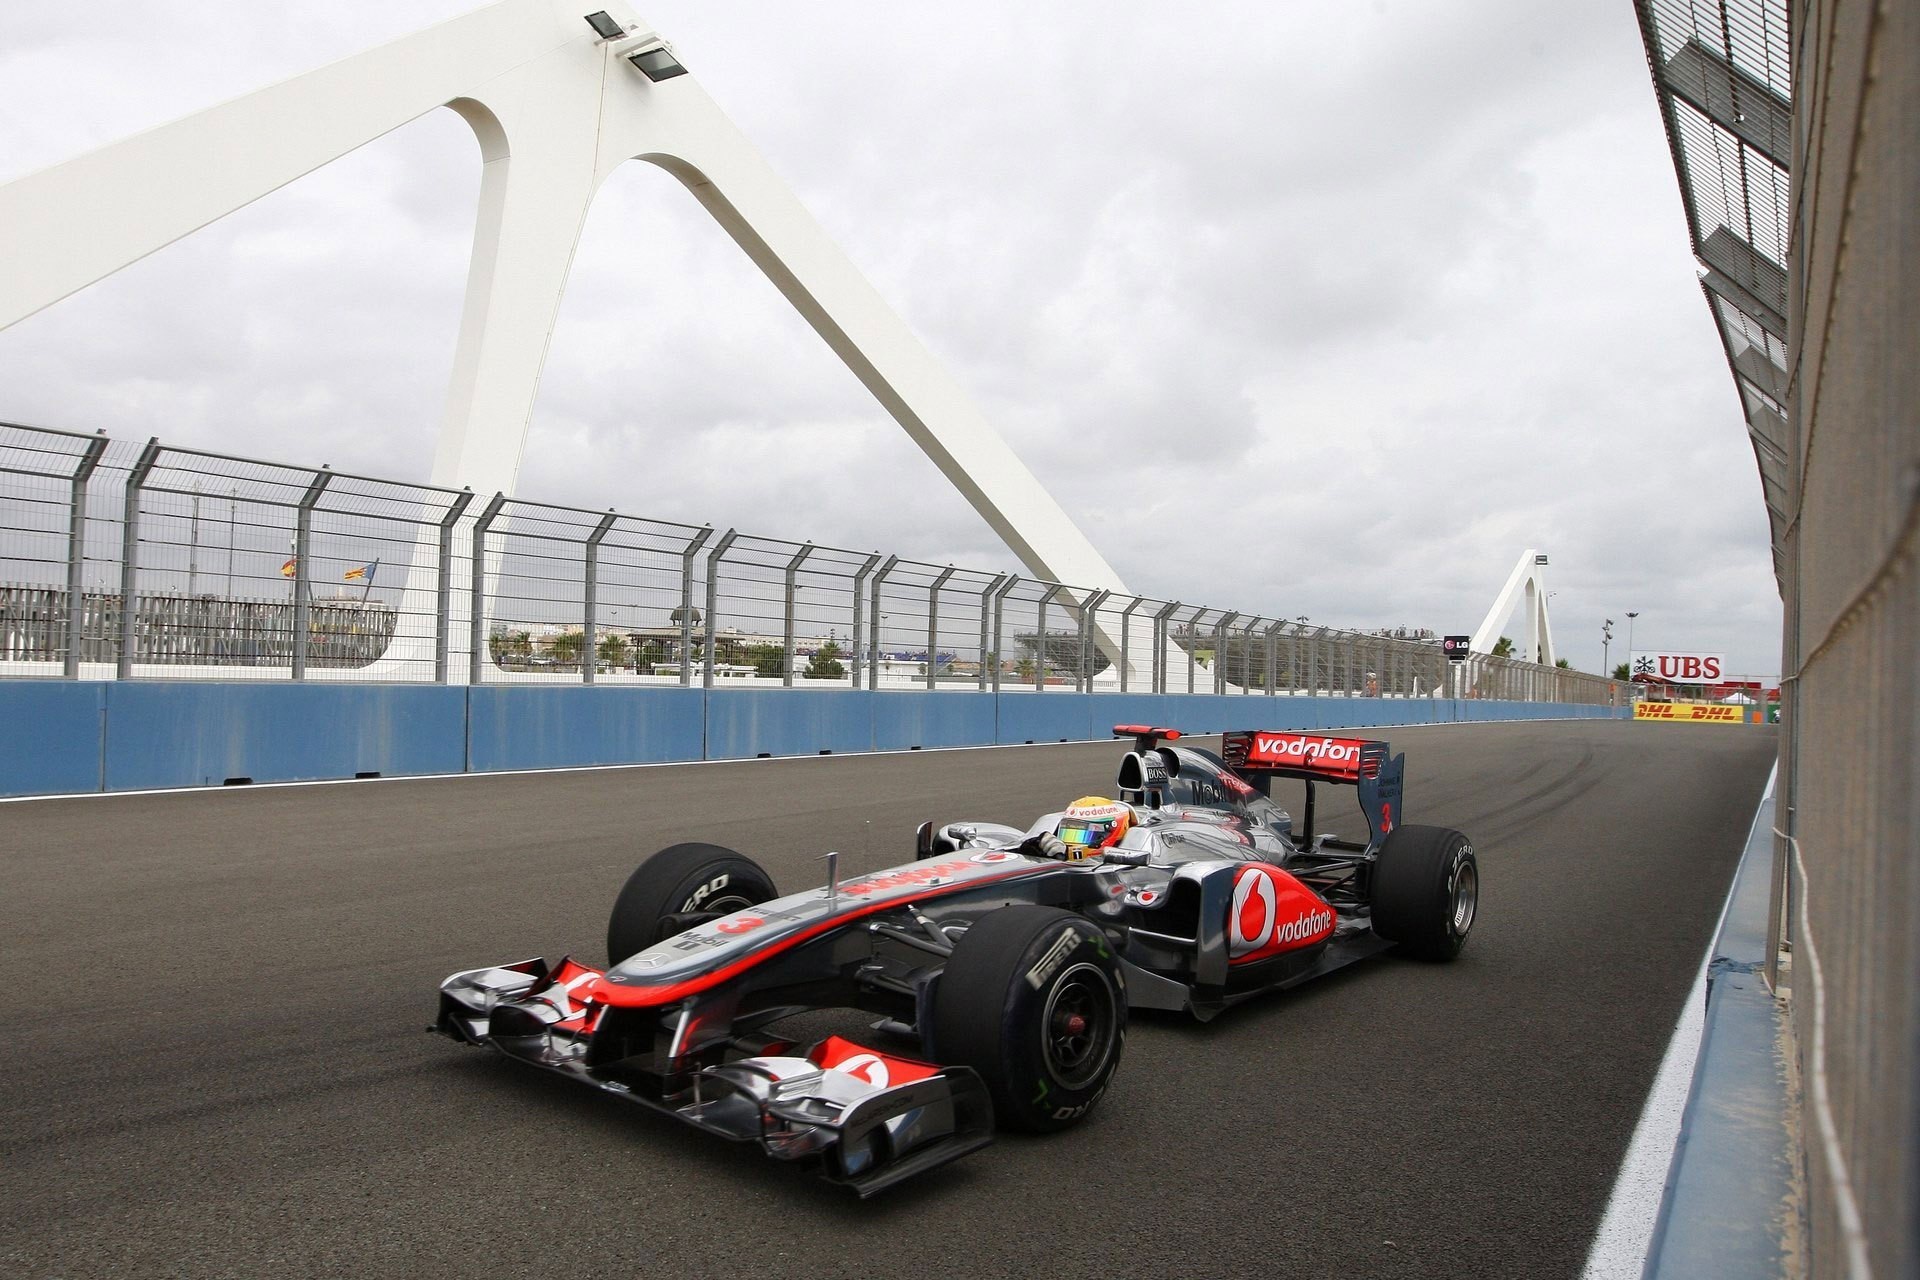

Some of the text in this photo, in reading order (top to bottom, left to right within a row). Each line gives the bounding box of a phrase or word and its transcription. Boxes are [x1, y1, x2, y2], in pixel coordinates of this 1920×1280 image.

[1456, 641, 1468, 649] LG
[1658, 655, 1720, 680] UBS
[1638, 704, 1736, 720] DHL DHL
[1258, 737, 1360, 762] vodafon
[1148, 768, 1168, 779] BOSS
[1079, 806, 1119, 817] vodafone
[1380, 802, 1391, 832] 3
[681, 874, 729, 912] ERO
[715, 917, 765, 934] 3
[1277, 908, 1331, 944] vodafone
[680, 931, 730, 947] Mobil
[1025, 927, 1082, 991] PIRELLI
